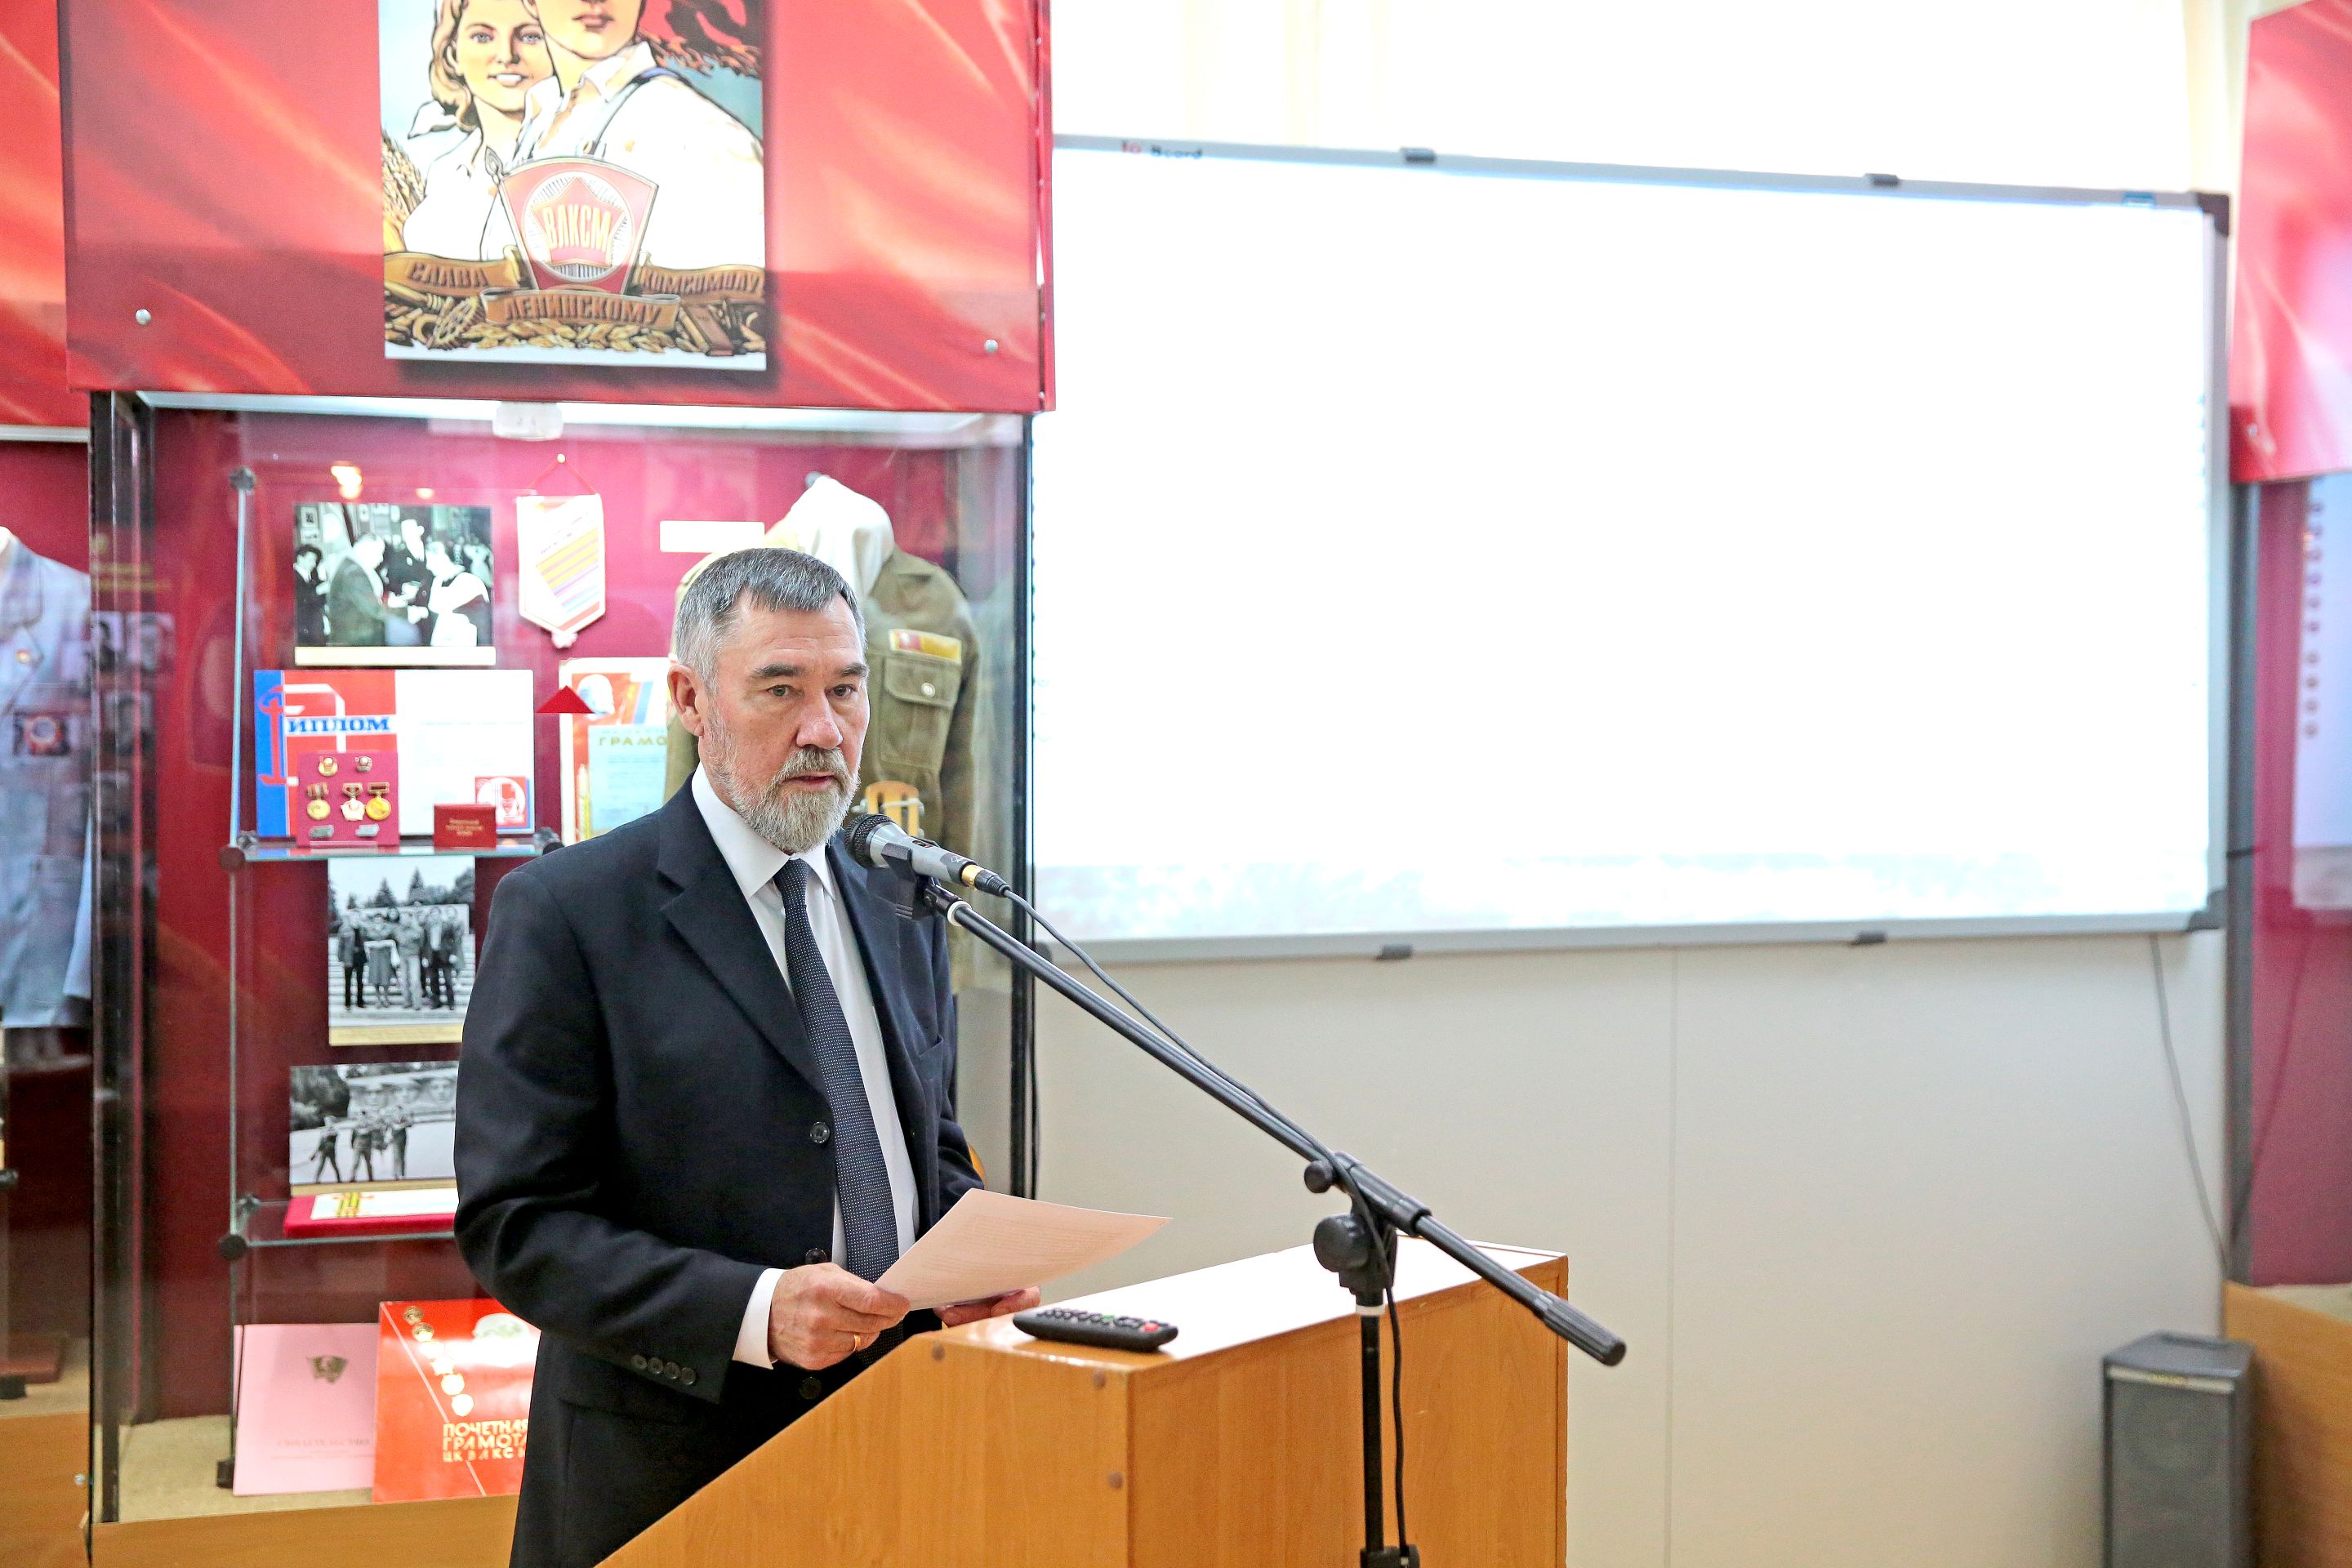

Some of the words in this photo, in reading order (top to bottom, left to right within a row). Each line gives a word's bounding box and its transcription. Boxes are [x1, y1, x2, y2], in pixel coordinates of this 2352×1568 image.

[541, 204, 612, 253] ВЛКСМ
[408, 261, 490, 288] СЛАВА
[503, 294, 663, 325] ЛЕНИНСКОМУ
